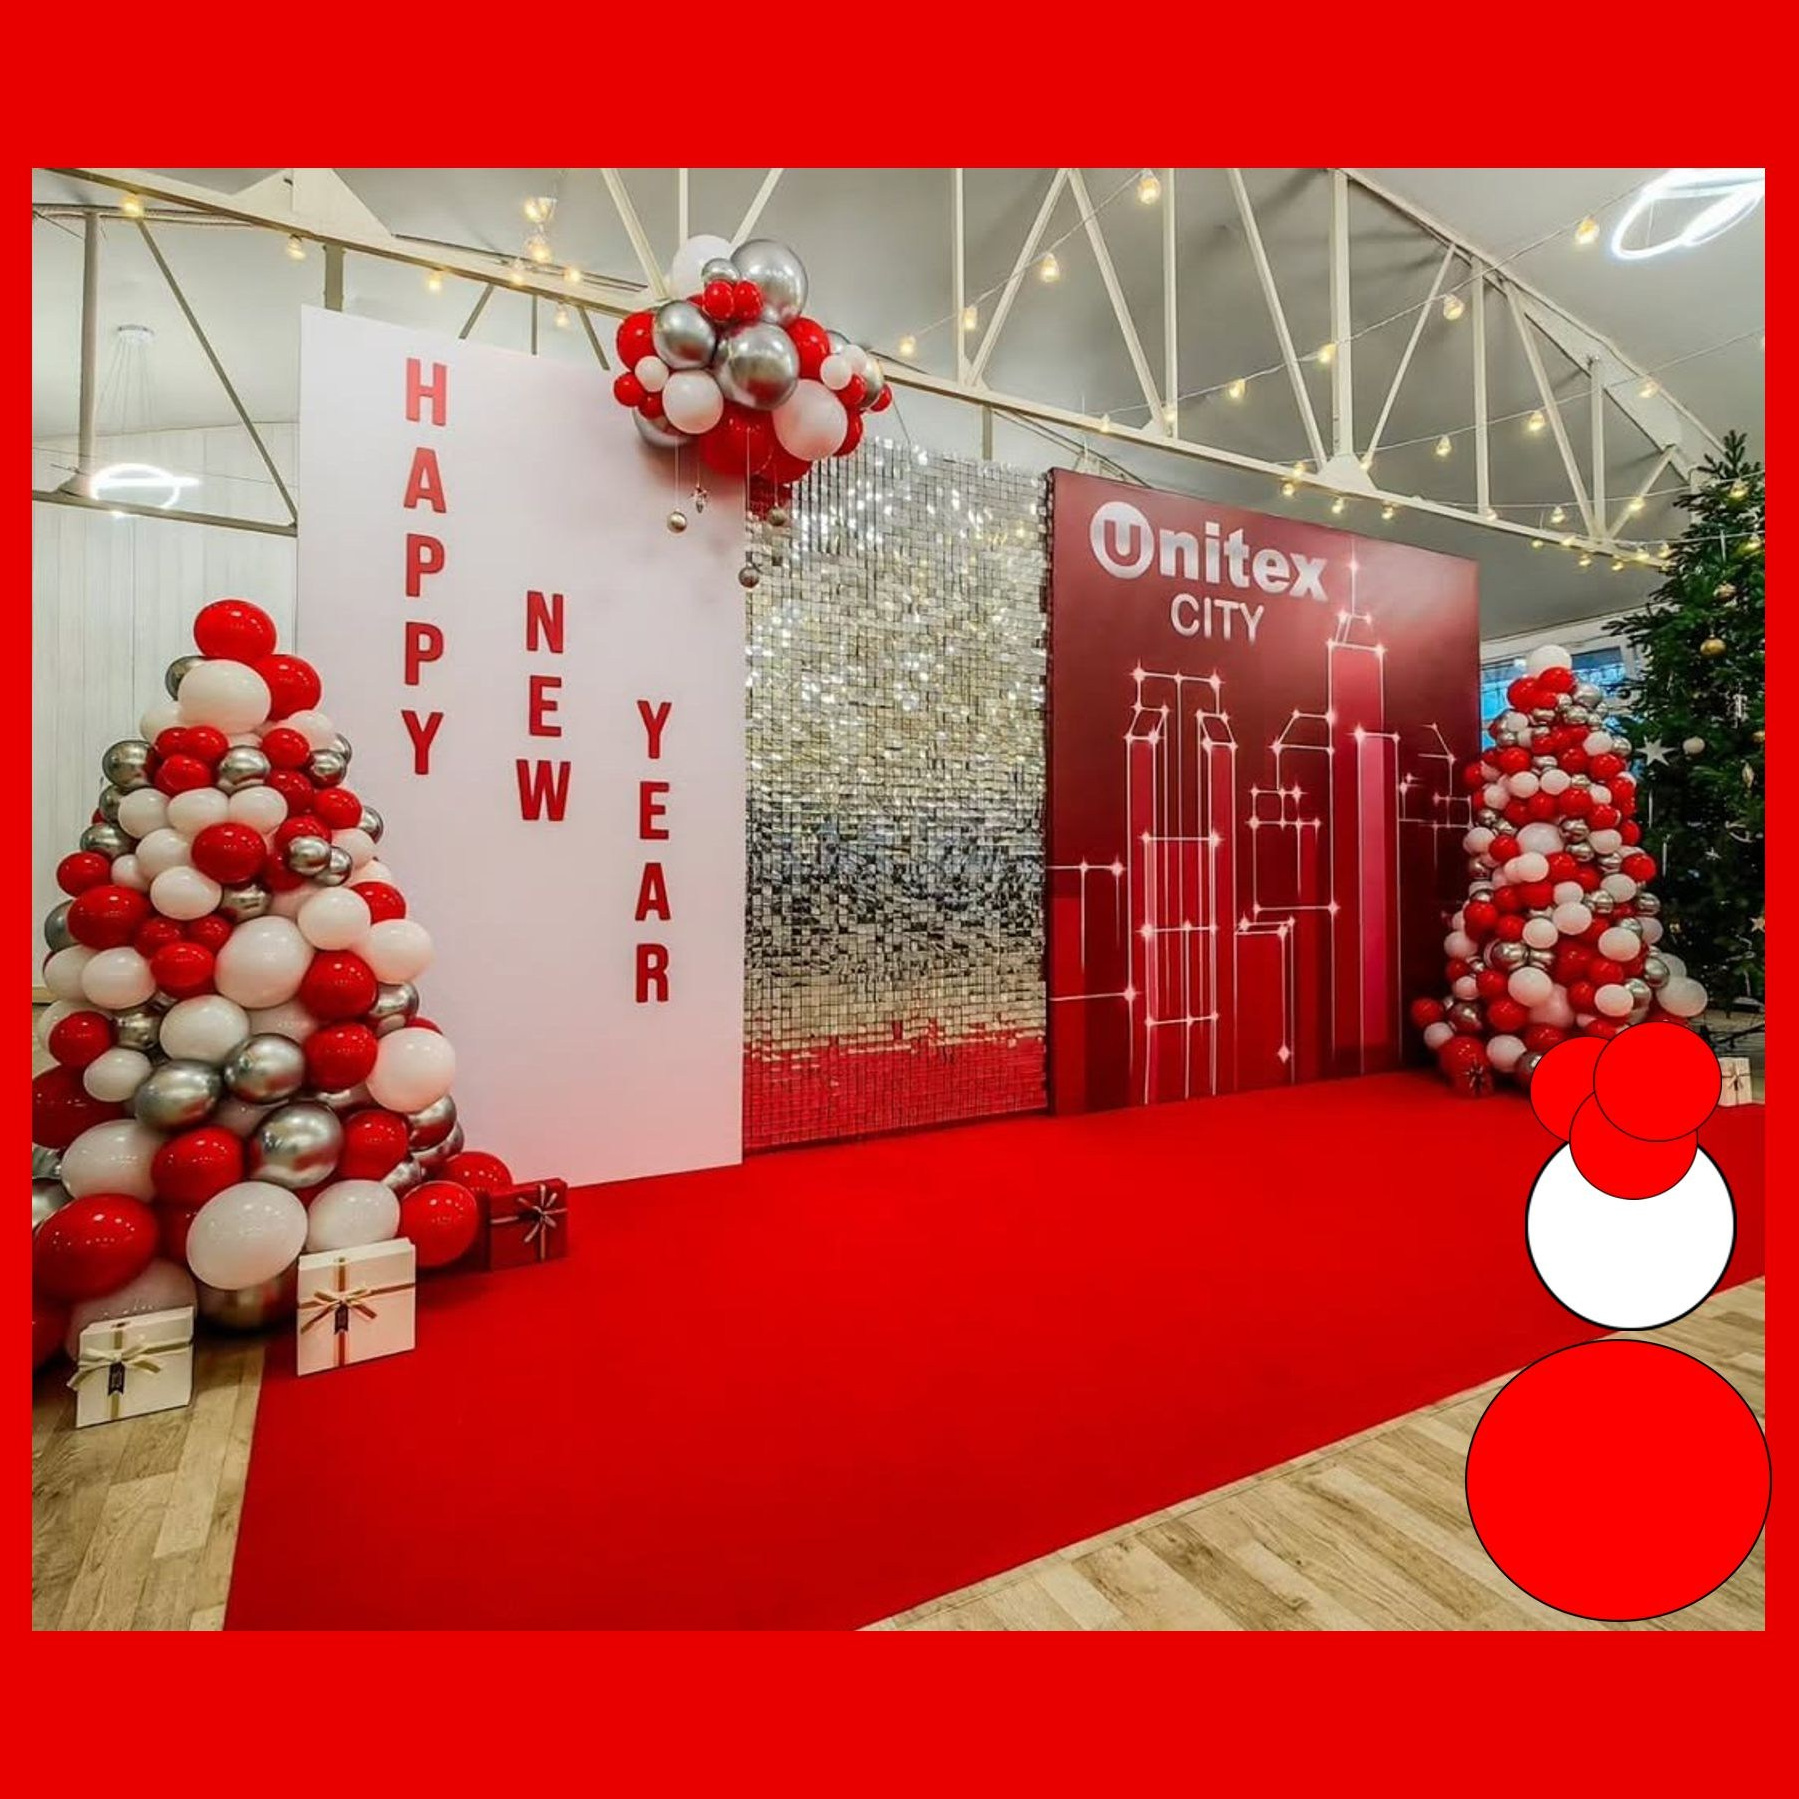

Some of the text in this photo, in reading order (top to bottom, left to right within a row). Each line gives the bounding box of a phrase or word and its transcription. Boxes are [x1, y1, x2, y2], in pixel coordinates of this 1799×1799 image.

[402, 358, 447, 776] HAPPY
[1090, 501, 1328, 601] Unitex
[1170, 593, 1265, 643] CITY
[516, 590, 571, 823] NEW
[635, 700, 671, 1005] YEAR
